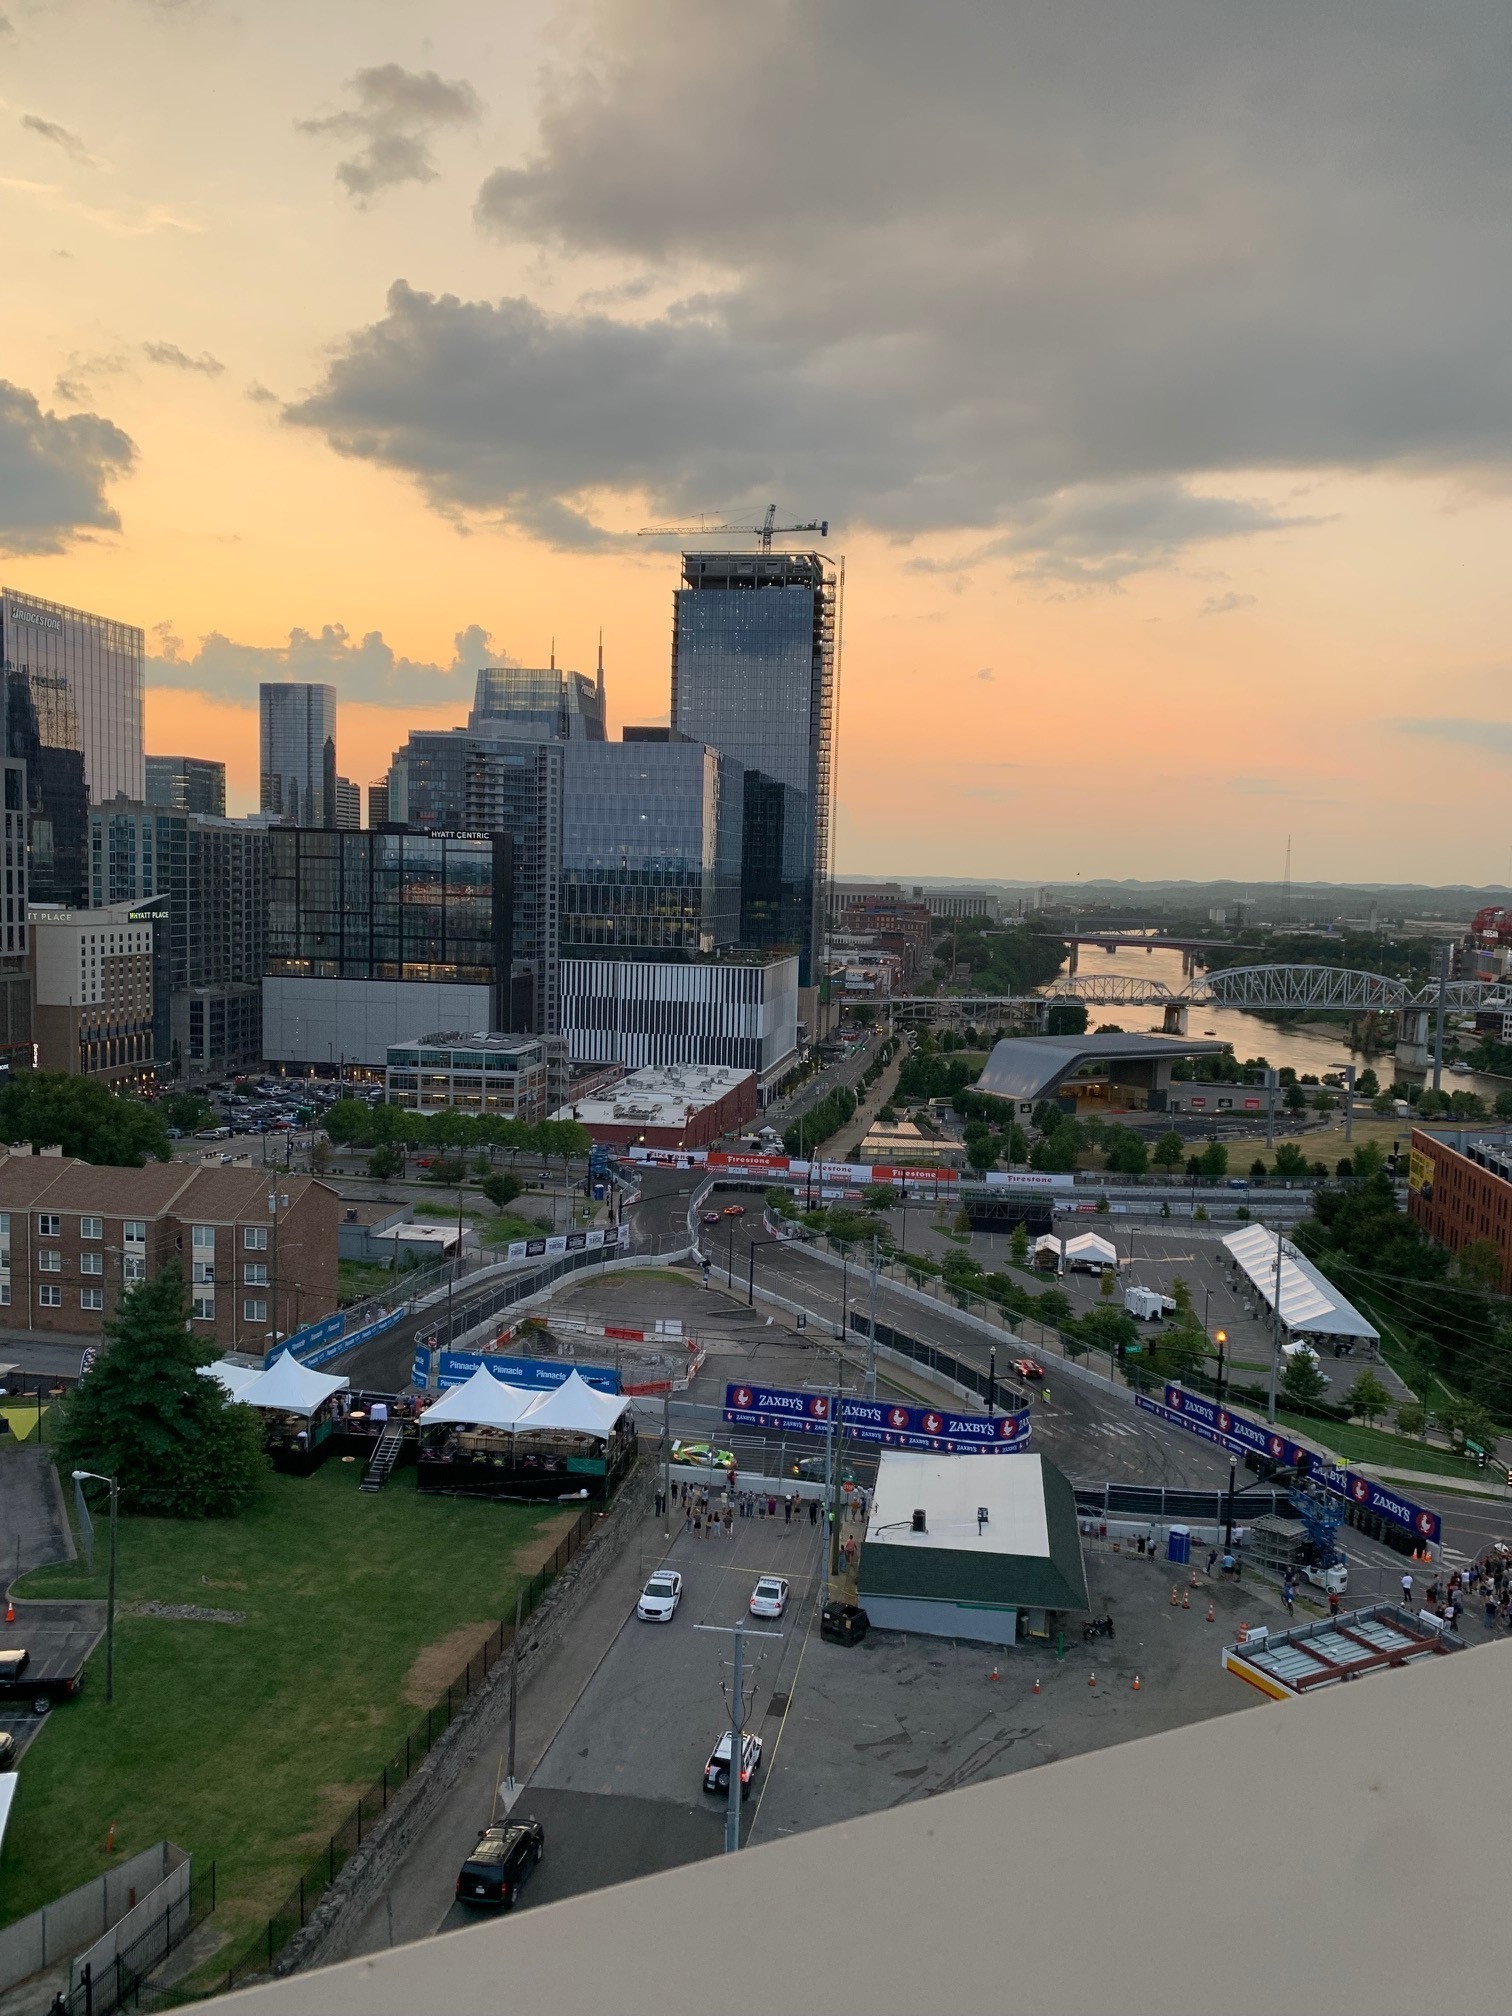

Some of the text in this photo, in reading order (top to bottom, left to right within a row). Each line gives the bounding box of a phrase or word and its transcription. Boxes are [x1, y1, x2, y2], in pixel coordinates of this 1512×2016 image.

[12, 607, 61, 630] BRIDGESTONE
[456, 831, 490, 839] CENTRIC
[41, 913, 72, 921] PLACE
[152, 911, 169, 919] PLACE
[727, 1155, 770, 1164] Firestone
[1007, 1175, 1052, 1183] Firestone
[449, 1360, 480, 1371] Pinnacle
[493, 1364, 523, 1376] Pinnacle
[536, 1369, 567, 1381] Pinnacle
[758, 1395, 804, 1411] ZAXBY'S
[1184, 1399, 1214, 1421] ZAXBY'S
[949, 1420, 995, 1436] ZAXBY'S
[1234, 1421, 1266, 1447] ZAXBY'S
[1372, 1492, 1411, 1523] ZAXBY'S
